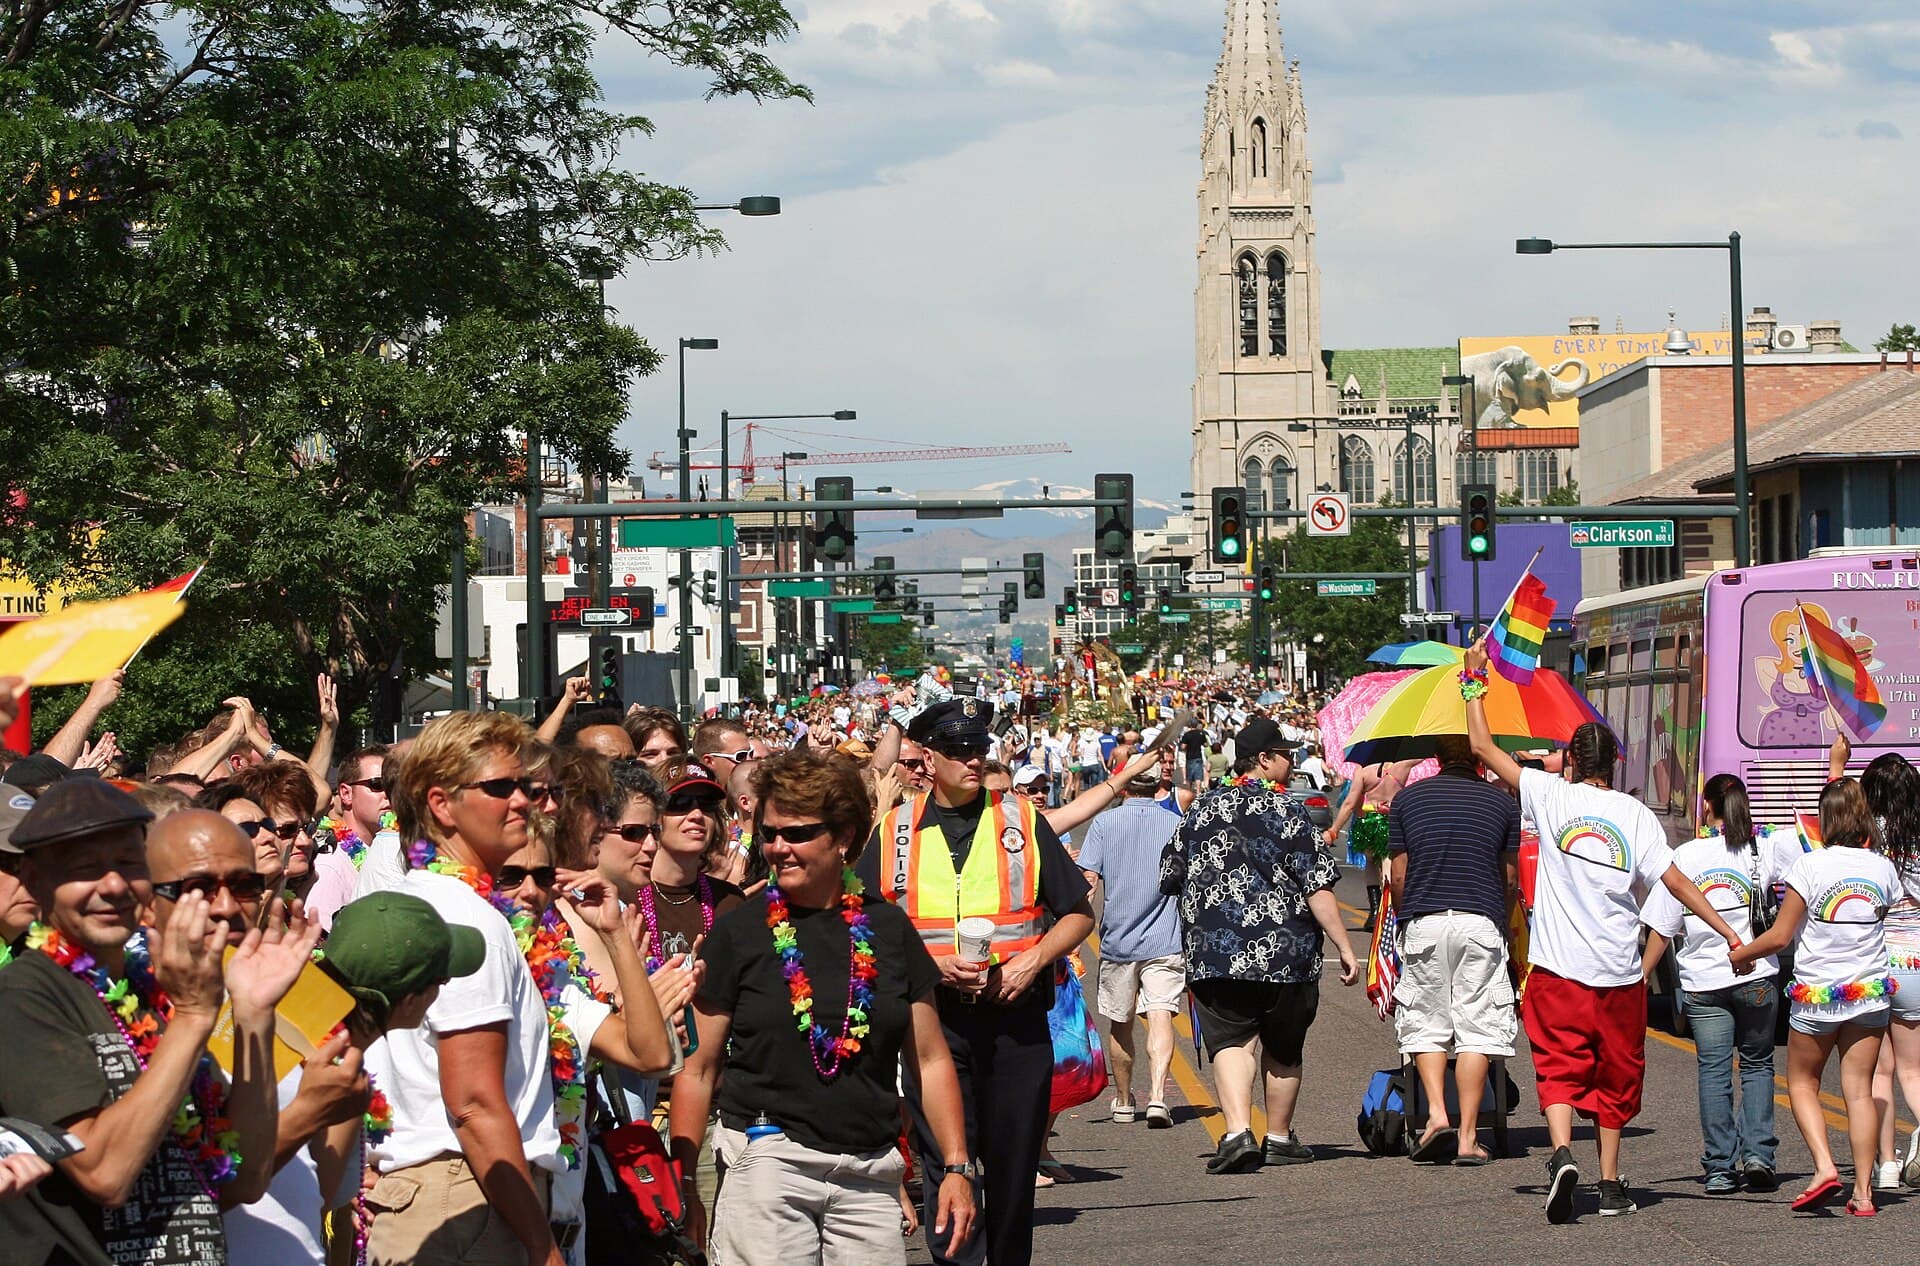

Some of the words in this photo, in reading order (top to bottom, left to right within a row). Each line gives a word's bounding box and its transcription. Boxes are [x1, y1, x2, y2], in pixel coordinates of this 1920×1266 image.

[1553, 338, 1606, 354] EVERY
[1590, 526, 1652, 543] Clarkson
[1328, 583, 1364, 594] Washington
[0, 596, 46, 614] TING
[1210, 601, 1226, 609] Pearl
[1889, 690, 1917, 703] 17th
[1697, 873, 1723, 887] QUALITY
[106, 1240, 142, 1253] FUCK
[144, 1234, 168, 1248] PAY
